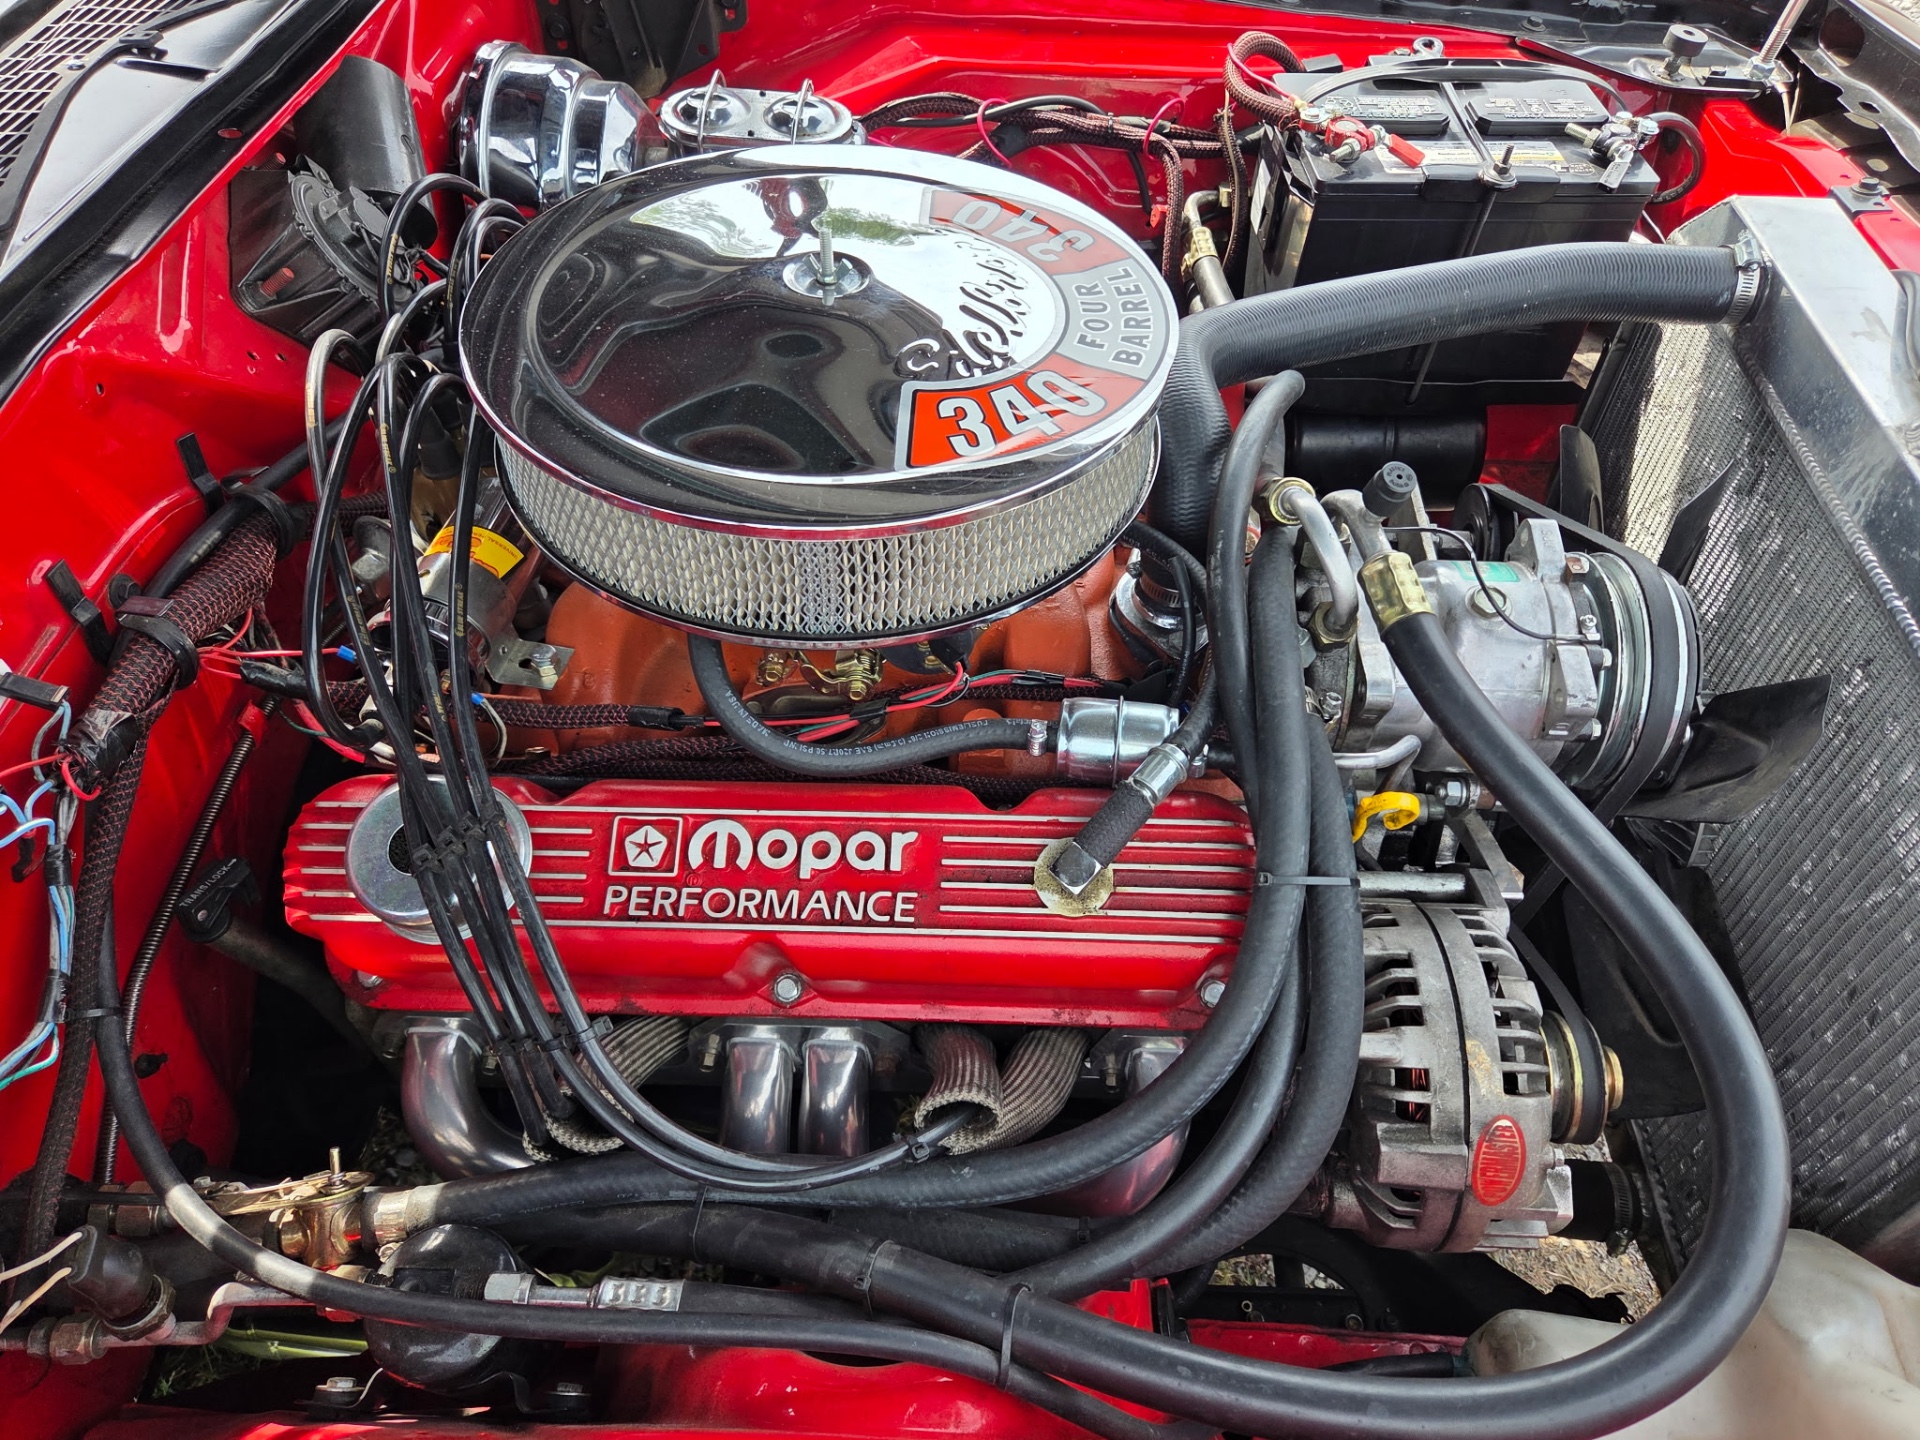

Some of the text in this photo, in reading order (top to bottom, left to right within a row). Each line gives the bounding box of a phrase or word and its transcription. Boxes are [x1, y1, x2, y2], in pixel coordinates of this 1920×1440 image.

[952, 201, 1096, 262] 340
[1077, 282, 1109, 351] FOUR
[1109, 266, 1154, 370] BARREL
[937, 370, 1107, 457] 340
[487, 536, 518, 560] UNIVERSAL
[724, 690, 740, 709] USA
[799, 746, 814, 754] PSI
[688, 819, 919, 879] Mopar
[179, 863, 231, 908] TRANS/LOCK
[603, 885, 919, 923] PERFORMANCE
[1479, 1126, 1520, 1198] POWERMASTER
